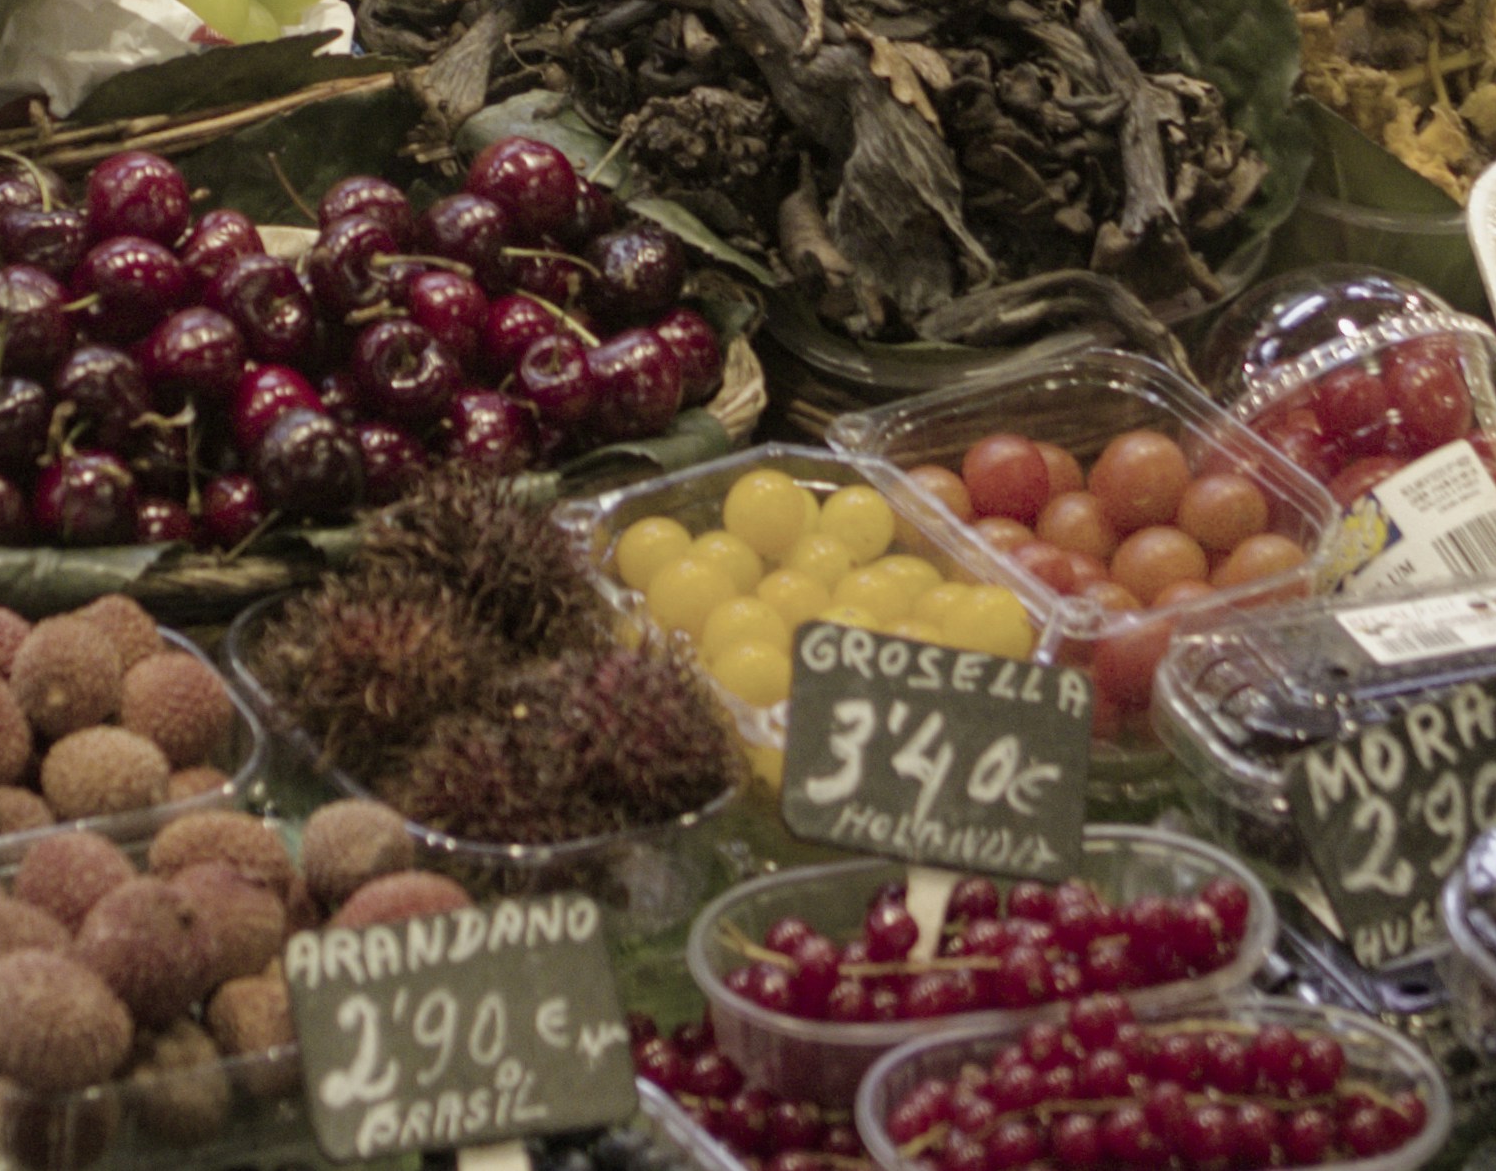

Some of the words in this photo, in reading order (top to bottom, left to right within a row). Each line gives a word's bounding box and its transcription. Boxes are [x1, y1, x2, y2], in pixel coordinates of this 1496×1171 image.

[801, 627, 1091, 720] GROSELLA
[284, 894, 601, 989] ARANDANO
[317, 985, 507, 1110] 2'90
